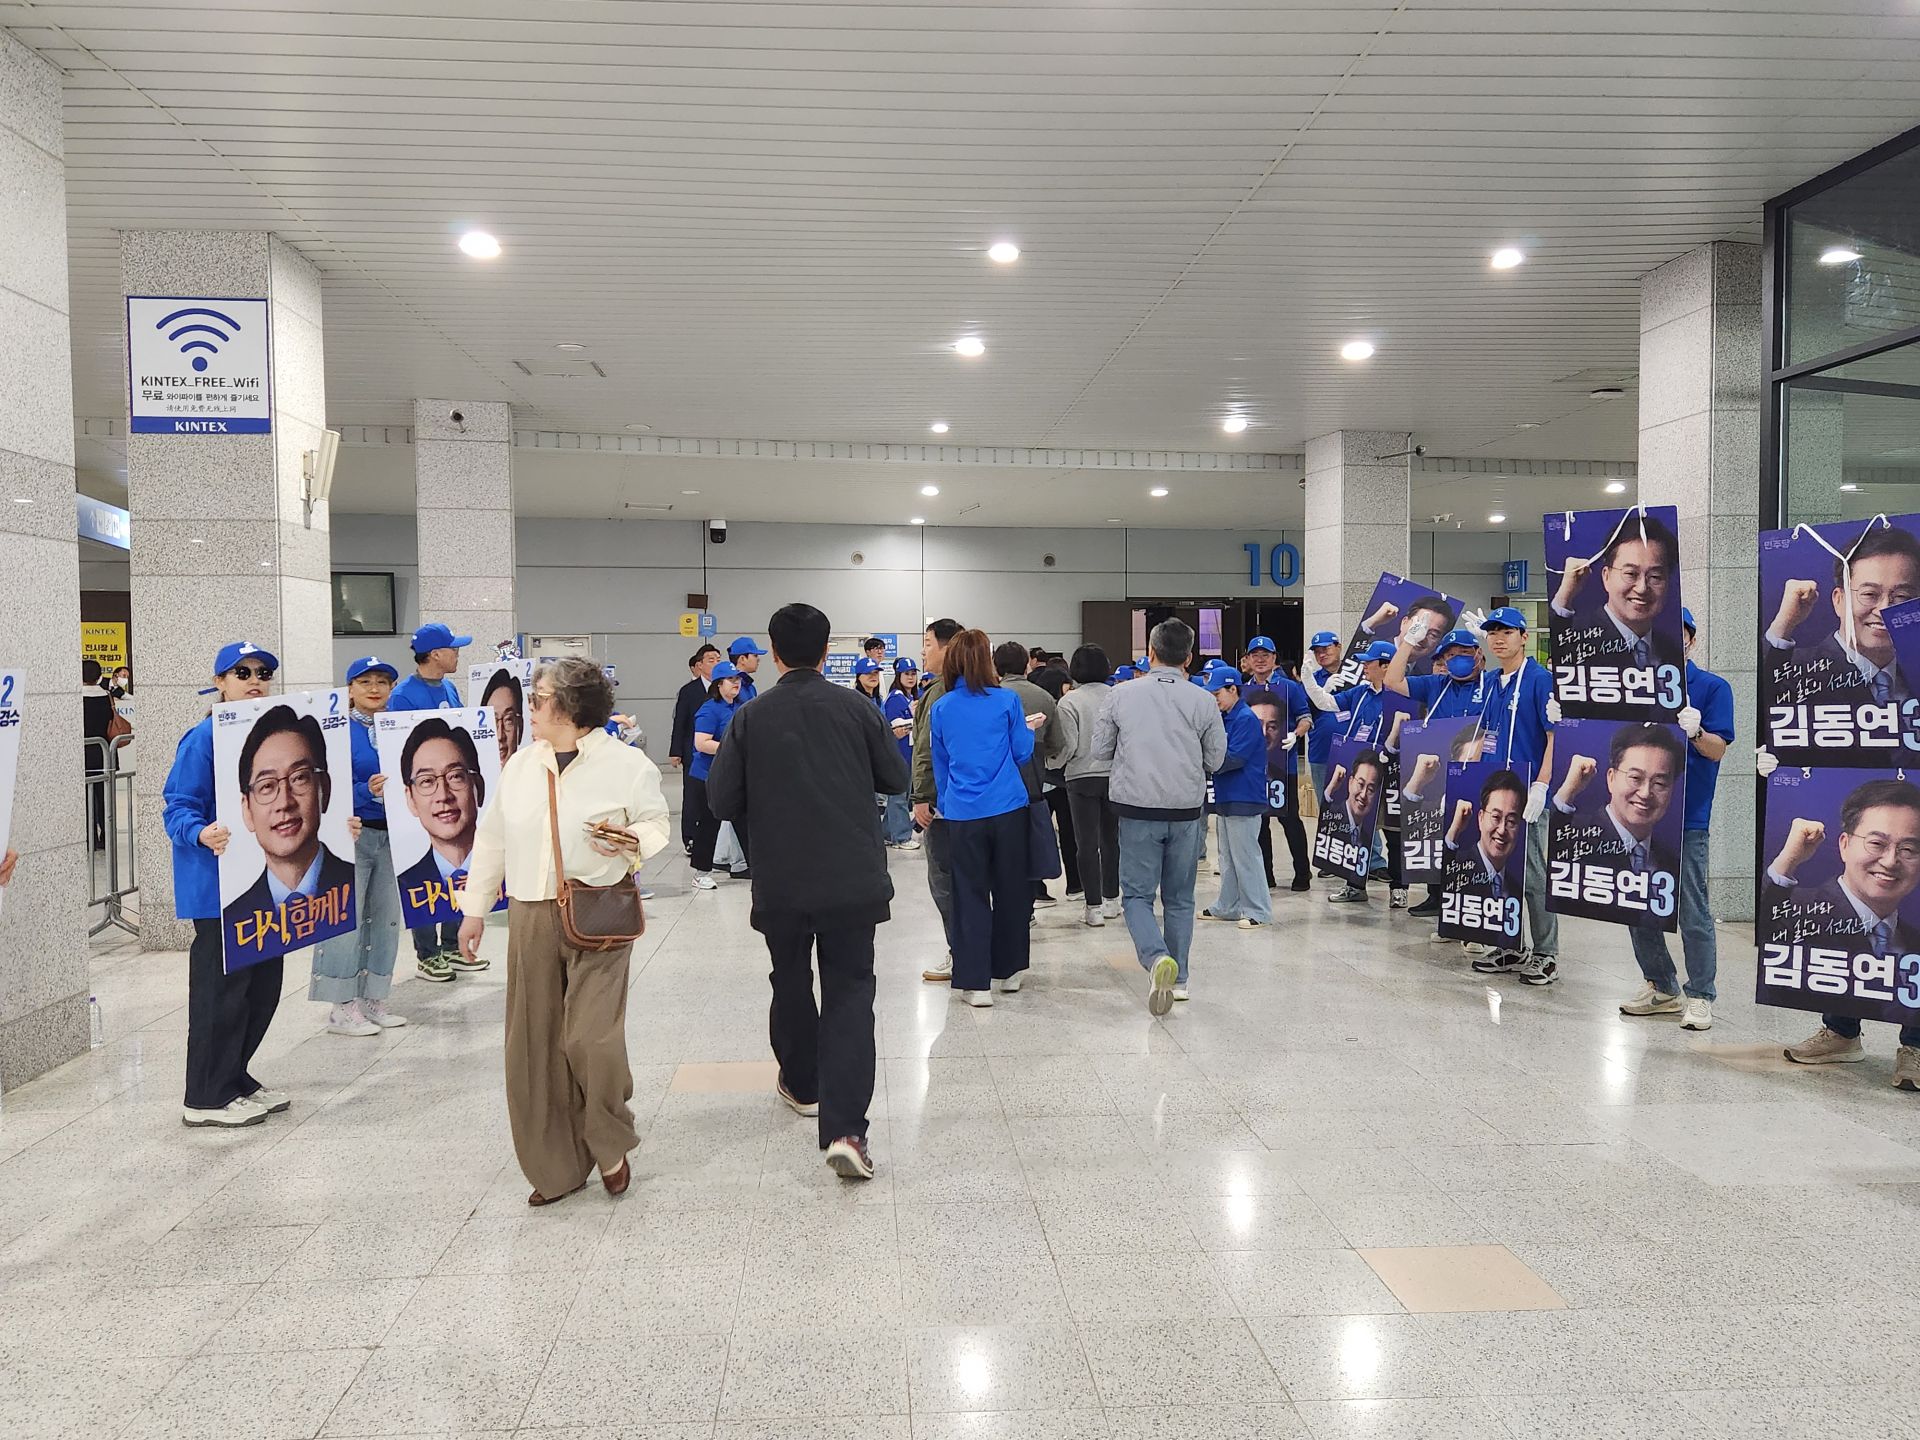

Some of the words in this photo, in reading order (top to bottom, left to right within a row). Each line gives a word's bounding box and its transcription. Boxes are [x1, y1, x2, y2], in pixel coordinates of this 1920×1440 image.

[141, 376, 260, 388] KINTEX_FREE_Wifi
[142, 390, 164, 401] 무료
[166, 392, 203, 402] 와이파이를
[205, 393, 228, 402] 편하게
[230, 394, 260, 402] 즐기세요
[174, 421, 228, 432] KINTEX
[1763, 537, 1792, 550] 민주당
[1243, 543, 1300, 587] 10
[1495, 608, 1504, 618] 3
[1256, 636, 1264, 647] 3
[1449, 632, 1457, 642] 3
[110, 644, 118, 652] 내
[525, 661, 532, 678] 2
[0, 675, 14, 708] 2
[329, 693, 340, 715] 2
[0, 709, 20, 727] 경수
[321, 715, 348, 731] 김경수
[477, 710, 487, 728] 2
[472, 728, 496, 740] 김경수
[1772, 774, 1801, 787] 민주당
